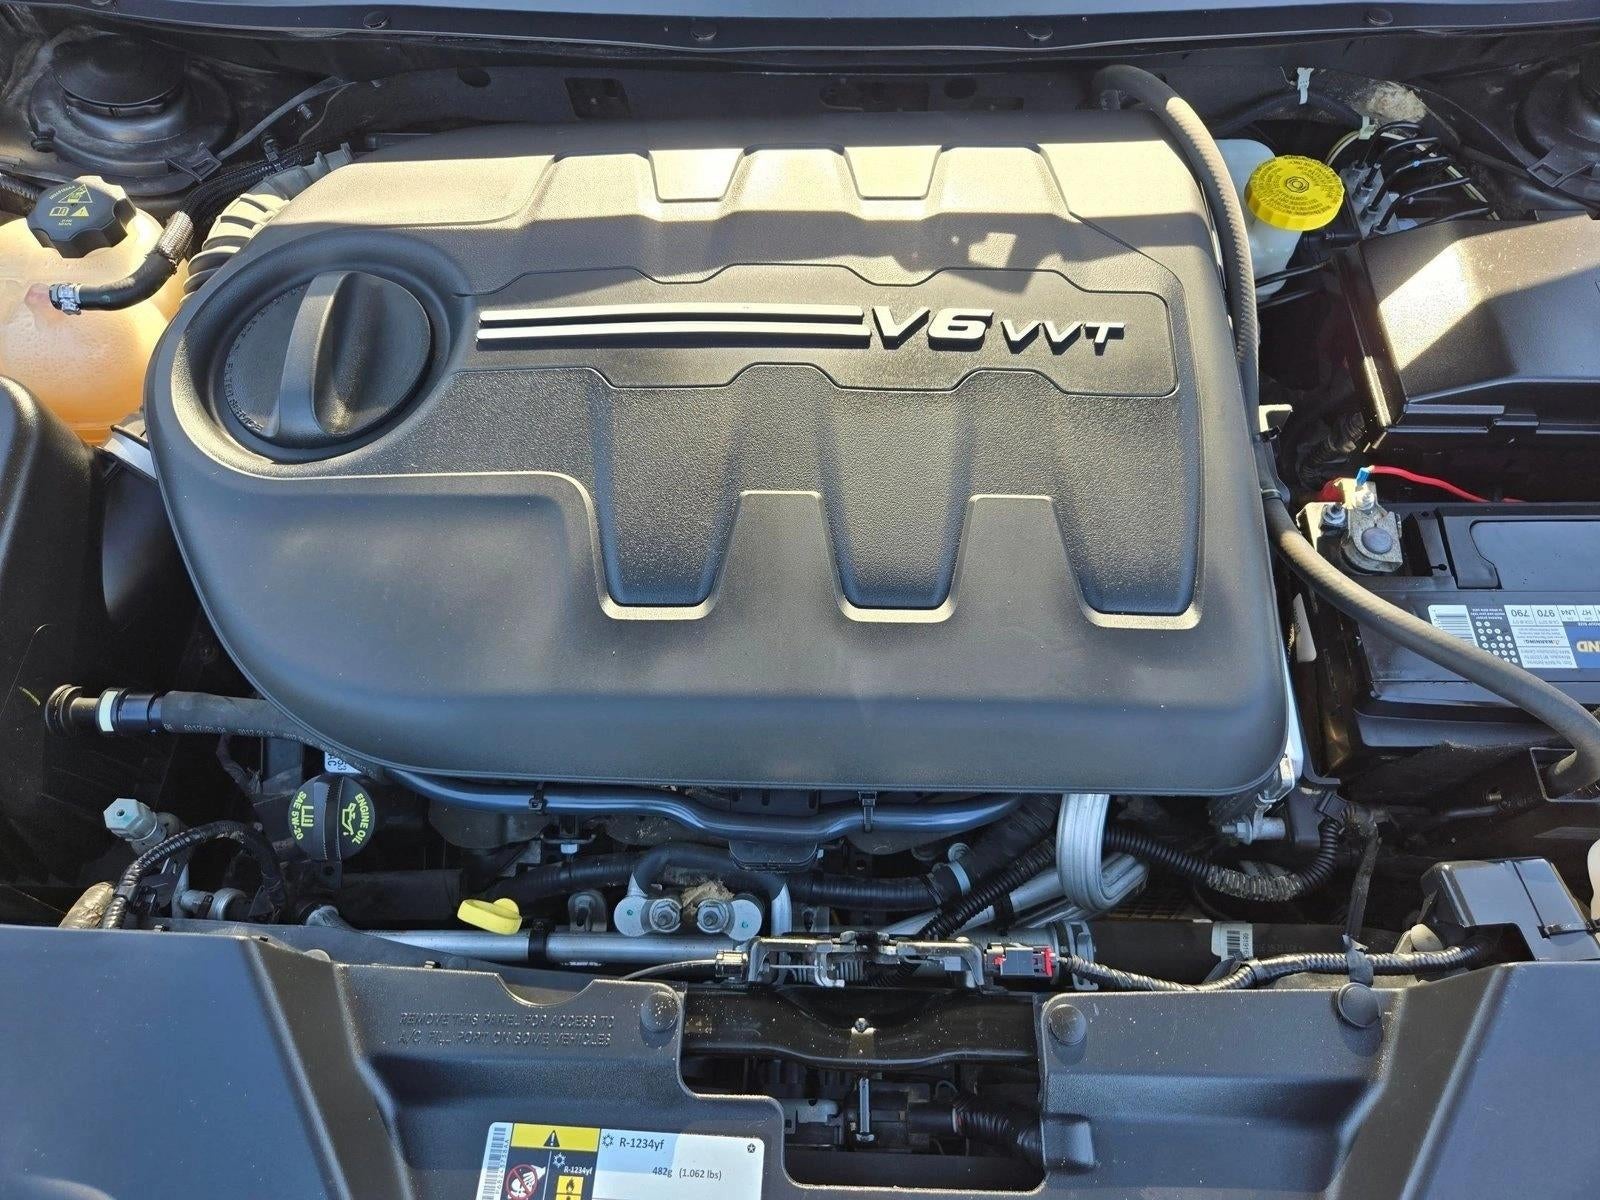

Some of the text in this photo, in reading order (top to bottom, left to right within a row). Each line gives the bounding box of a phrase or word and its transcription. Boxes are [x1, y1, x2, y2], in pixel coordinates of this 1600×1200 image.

[872, 305, 1125, 356] V6 VVT
[1510, 609, 1531, 618] 790
[1537, 609, 1555, 618] 970
[1561, 609, 1577, 617] LN4
[291, 791, 307, 840] SAE 5W-20
[354, 793, 370, 829] ENGINE
[351, 829, 366, 844] OIL
[399, 1011, 615, 1028] REMOVE THIS PANEL FOR ACCESS TO
[458, 1031, 489, 1045] PORT
[493, 1031, 512, 1046] ON
[514, 1032, 550, 1046] SOME
[554, 1032, 612, 1047] VEHICLES
[619, 1137, 665, 1151] R-1234yf
[563, 1165, 593, 1177] R-1234yf
[652, 1167, 722, 1181] 482g (1.062 lbs)
